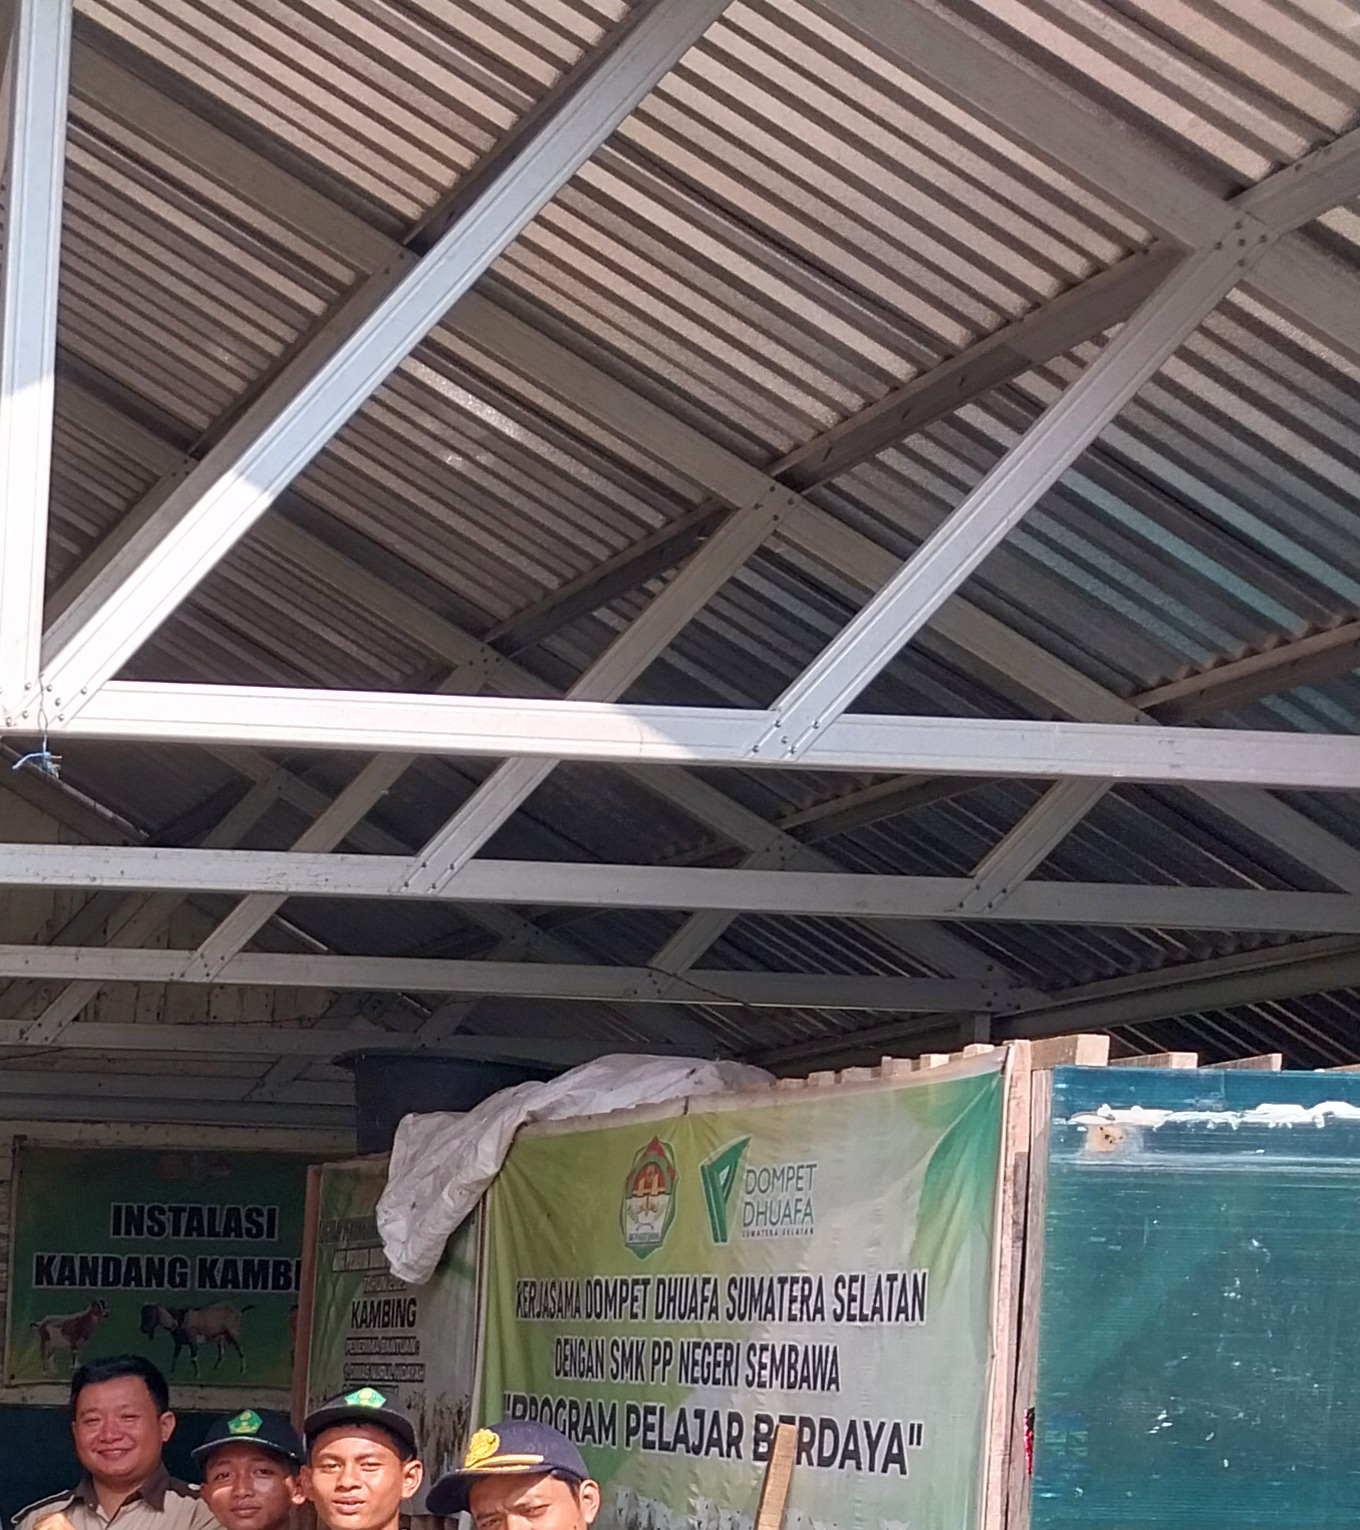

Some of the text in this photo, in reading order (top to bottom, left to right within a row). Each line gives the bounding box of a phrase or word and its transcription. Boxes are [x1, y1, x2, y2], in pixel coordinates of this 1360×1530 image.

[745, 1164, 818, 1195] DOMPET
[111, 1204, 277, 1239] INSTALASI
[742, 1200, 815, 1228] DHUAFA
[742, 1227, 815, 1238] SUMATERA SELATAN
[34, 1253, 189, 1289] KANDANG
[351, 1298, 417, 1329] KAMBING
[515, 1271, 927, 1324] KERJASAMA DOMPET DHUAFA SUMATERA SELATAN
[554, 1337, 841, 1393] DENGAN SMK PP NEGERI SEMBAWA
[625, 1404, 744, 1460] PELAJAR
